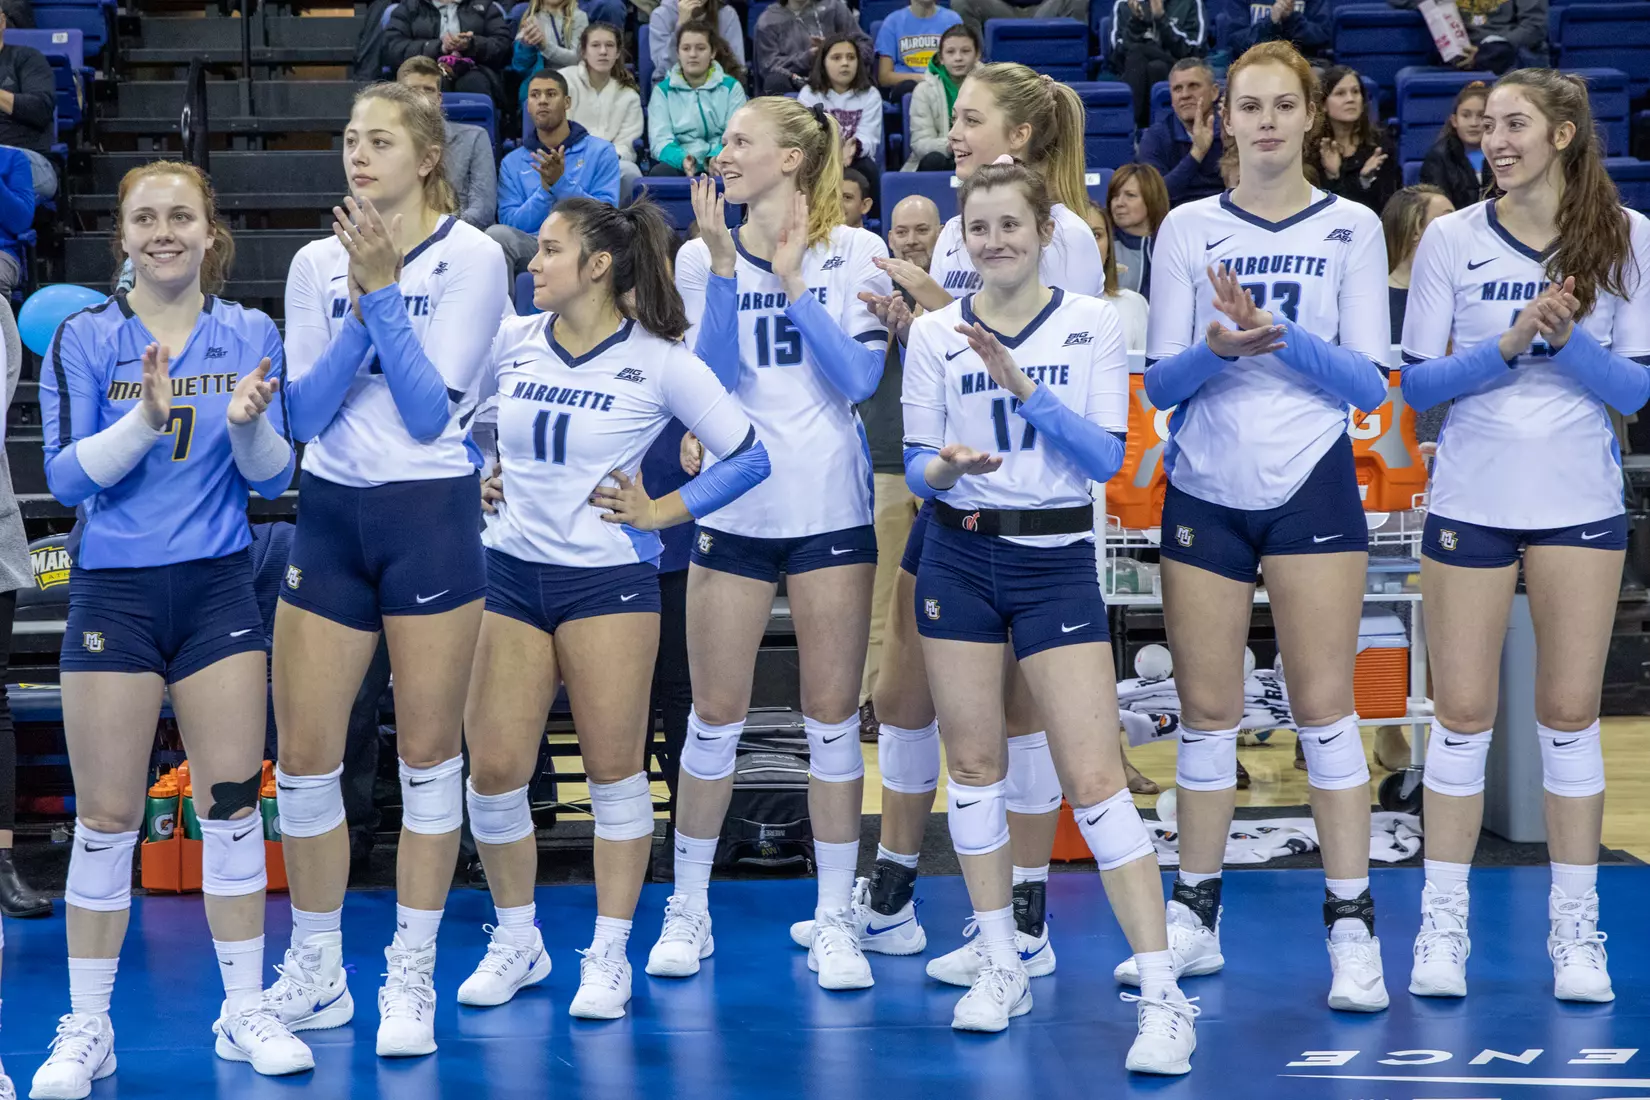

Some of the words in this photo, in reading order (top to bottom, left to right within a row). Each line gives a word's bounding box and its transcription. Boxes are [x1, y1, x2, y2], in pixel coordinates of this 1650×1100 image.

[754, 314, 803, 368] 15
[107, 372, 239, 400] MAUETTE
[615, 372, 647, 384] EAST
[621, 367, 643, 376] BIG
[511, 381, 617, 412] MARQUETTE
[163, 405, 196, 462] 7
[532, 409, 571, 466] 11
[988, 396, 1040, 453] 17
[82, 631, 105, 653] MU
[154, 813, 174, 836] G
